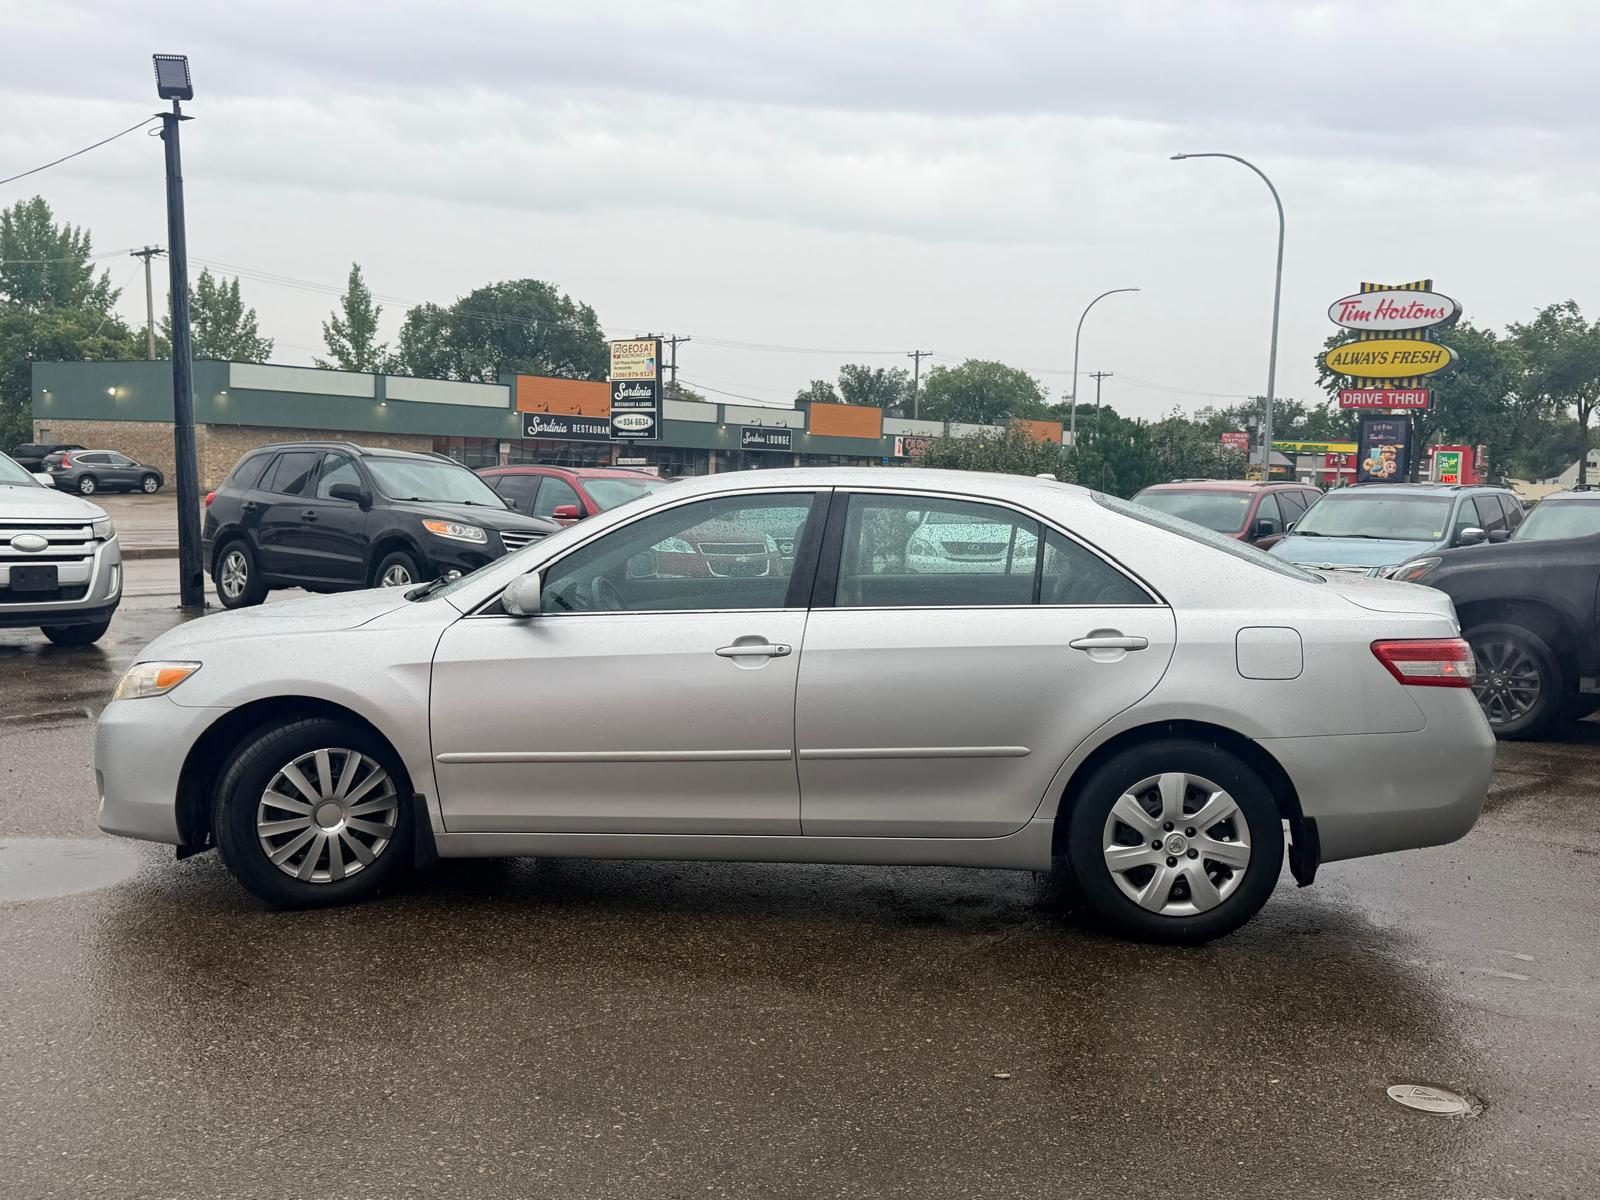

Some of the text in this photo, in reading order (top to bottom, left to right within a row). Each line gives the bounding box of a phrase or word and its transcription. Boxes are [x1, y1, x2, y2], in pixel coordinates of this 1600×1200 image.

[1339, 298, 1445, 322] Tim Hortons
[622, 343, 653, 353] GEOSAT
[1331, 350, 1442, 365] ALWAYS FRESH
[614, 382, 652, 400] Sardinia
[1343, 393, 1425, 405] DRIVE THRU
[528, 416, 610, 435] Sardinia RESTAURAN
[742, 431, 790, 445] Sardinia LOUNGE
